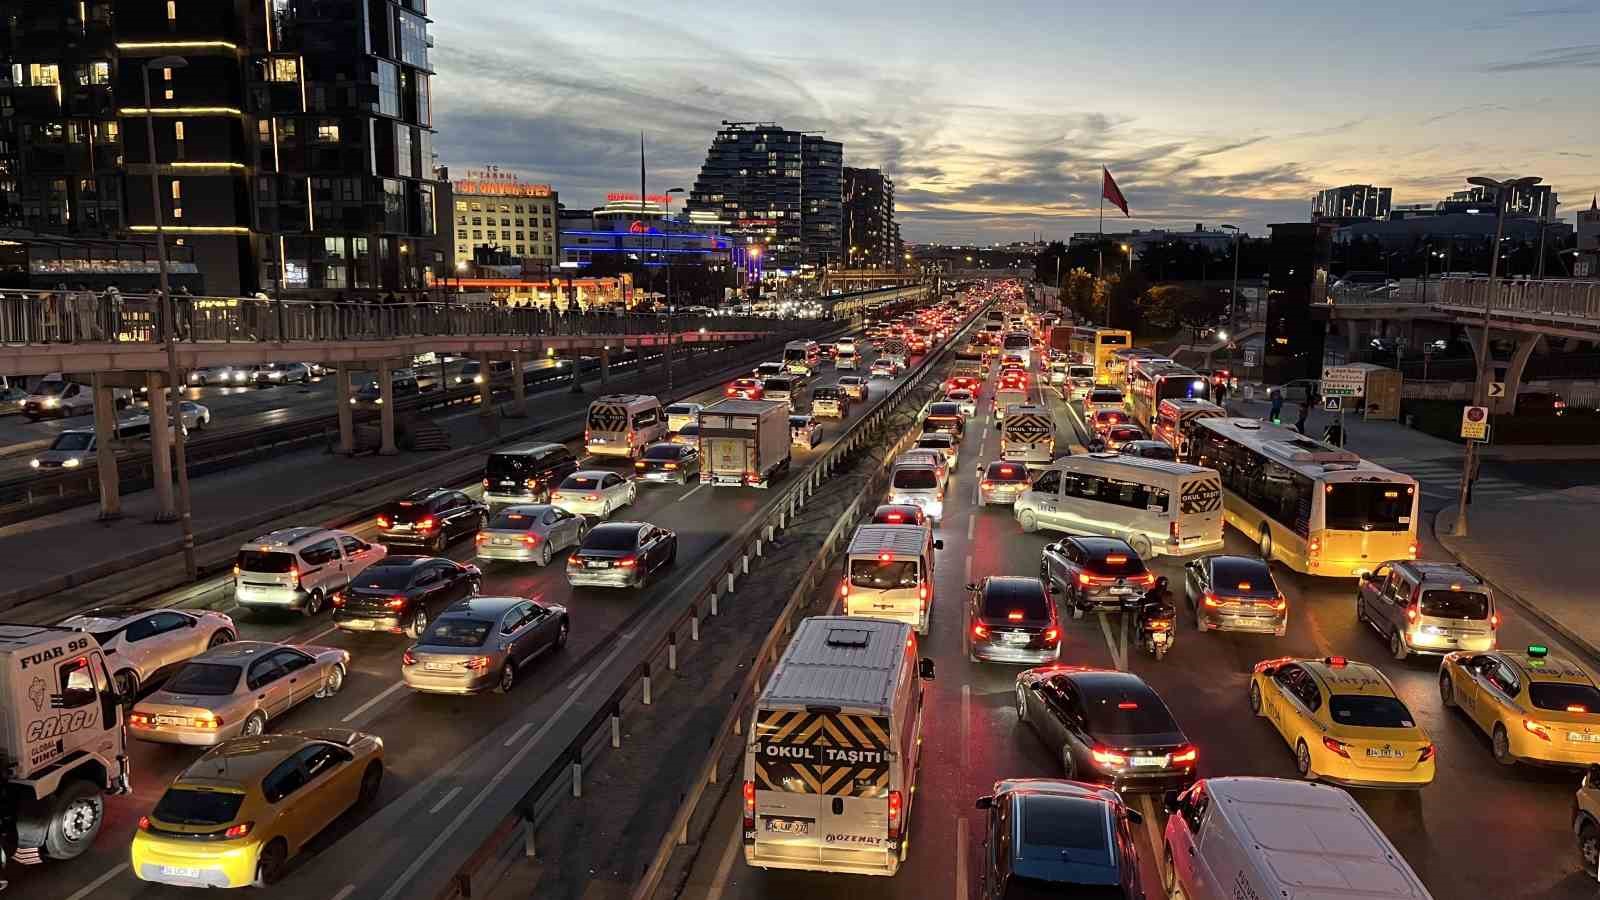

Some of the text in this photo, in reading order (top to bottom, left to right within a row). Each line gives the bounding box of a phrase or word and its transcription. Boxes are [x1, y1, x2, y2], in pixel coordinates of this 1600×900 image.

[20, 638, 88, 669] FUAR 98
[26, 710, 98, 743] CARGO
[766, 745, 881, 764] OKUL TAŞITI
